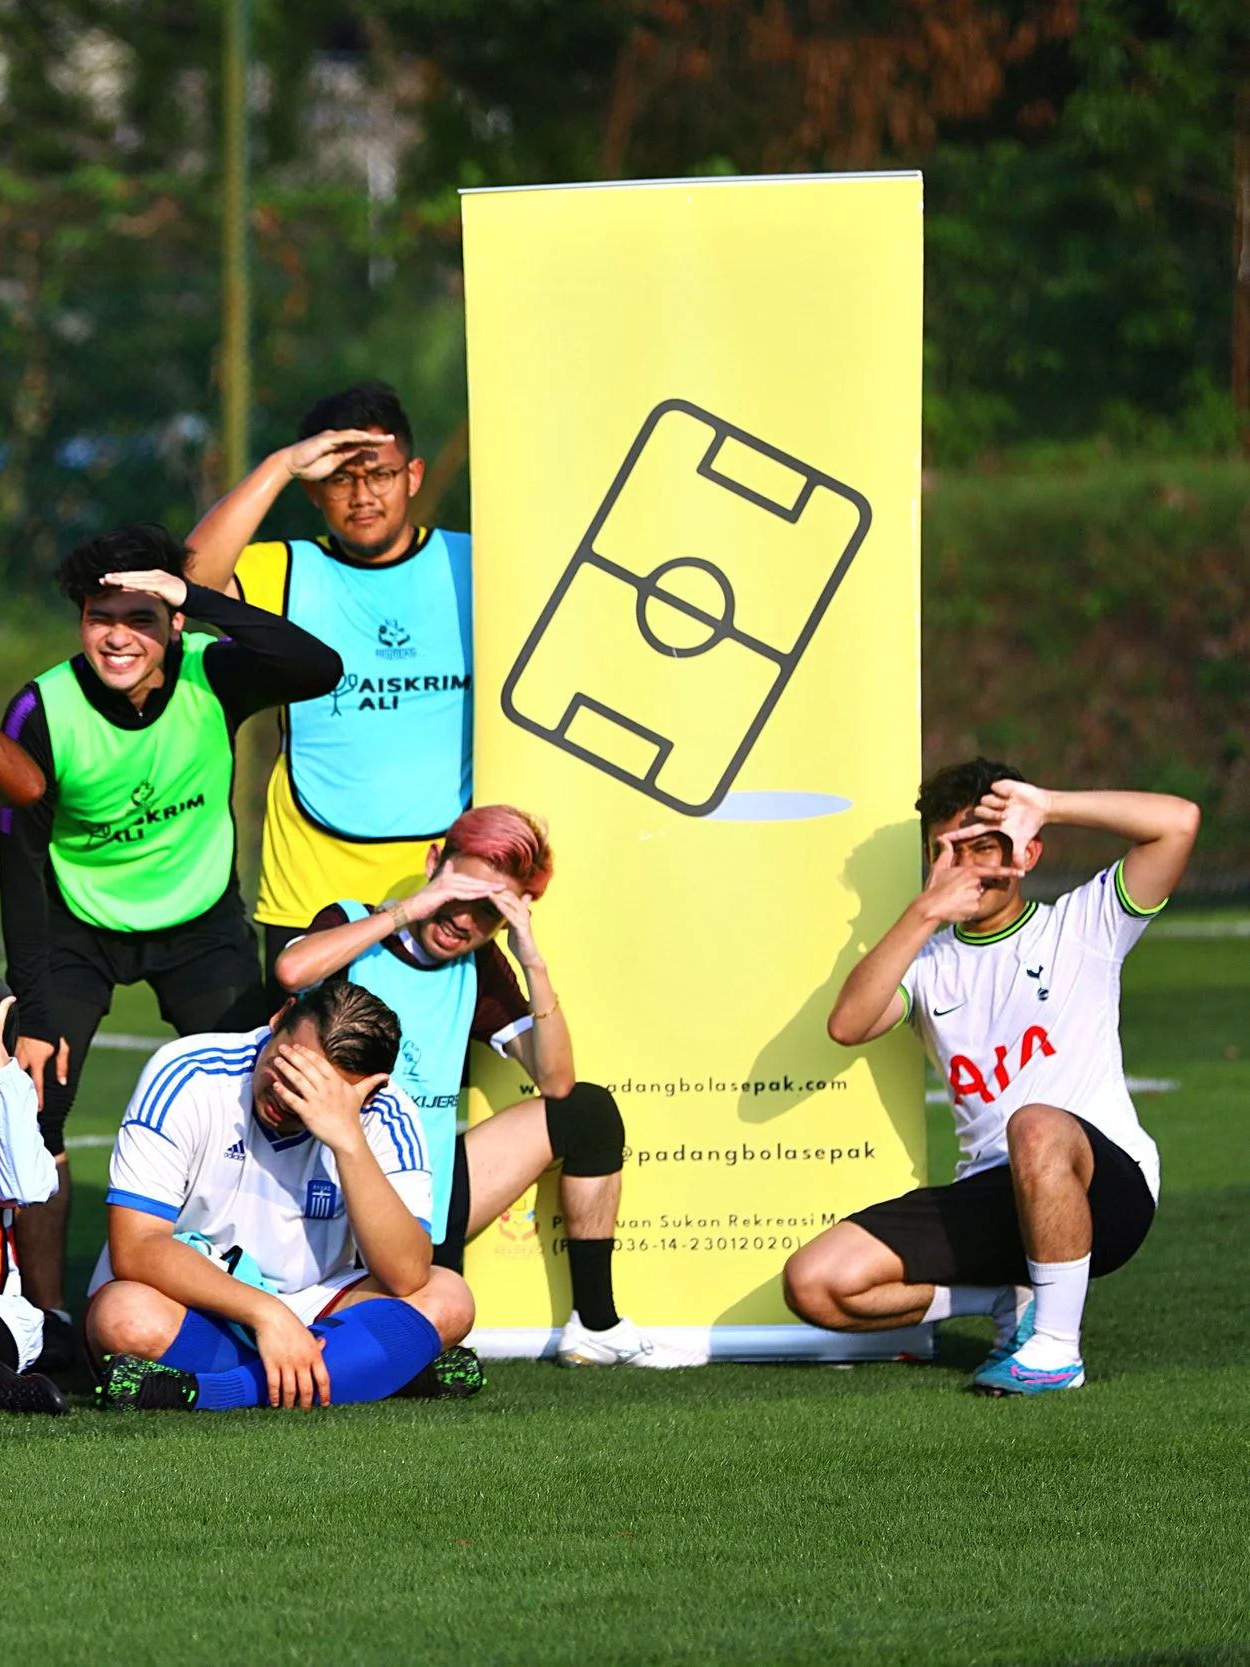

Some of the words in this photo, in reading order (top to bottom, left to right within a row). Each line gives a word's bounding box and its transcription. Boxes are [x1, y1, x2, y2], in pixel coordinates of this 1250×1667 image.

[358, 674, 472, 693] AISKRIM
[358, 695, 399, 711] ALI
[950, 1025, 1056, 1105] AIA
[519, 1075, 848, 1098] wadangbolasepak.com
[660, 1214, 720, 1228] Sukan
[728, 1213, 815, 1227] Rekreasi
